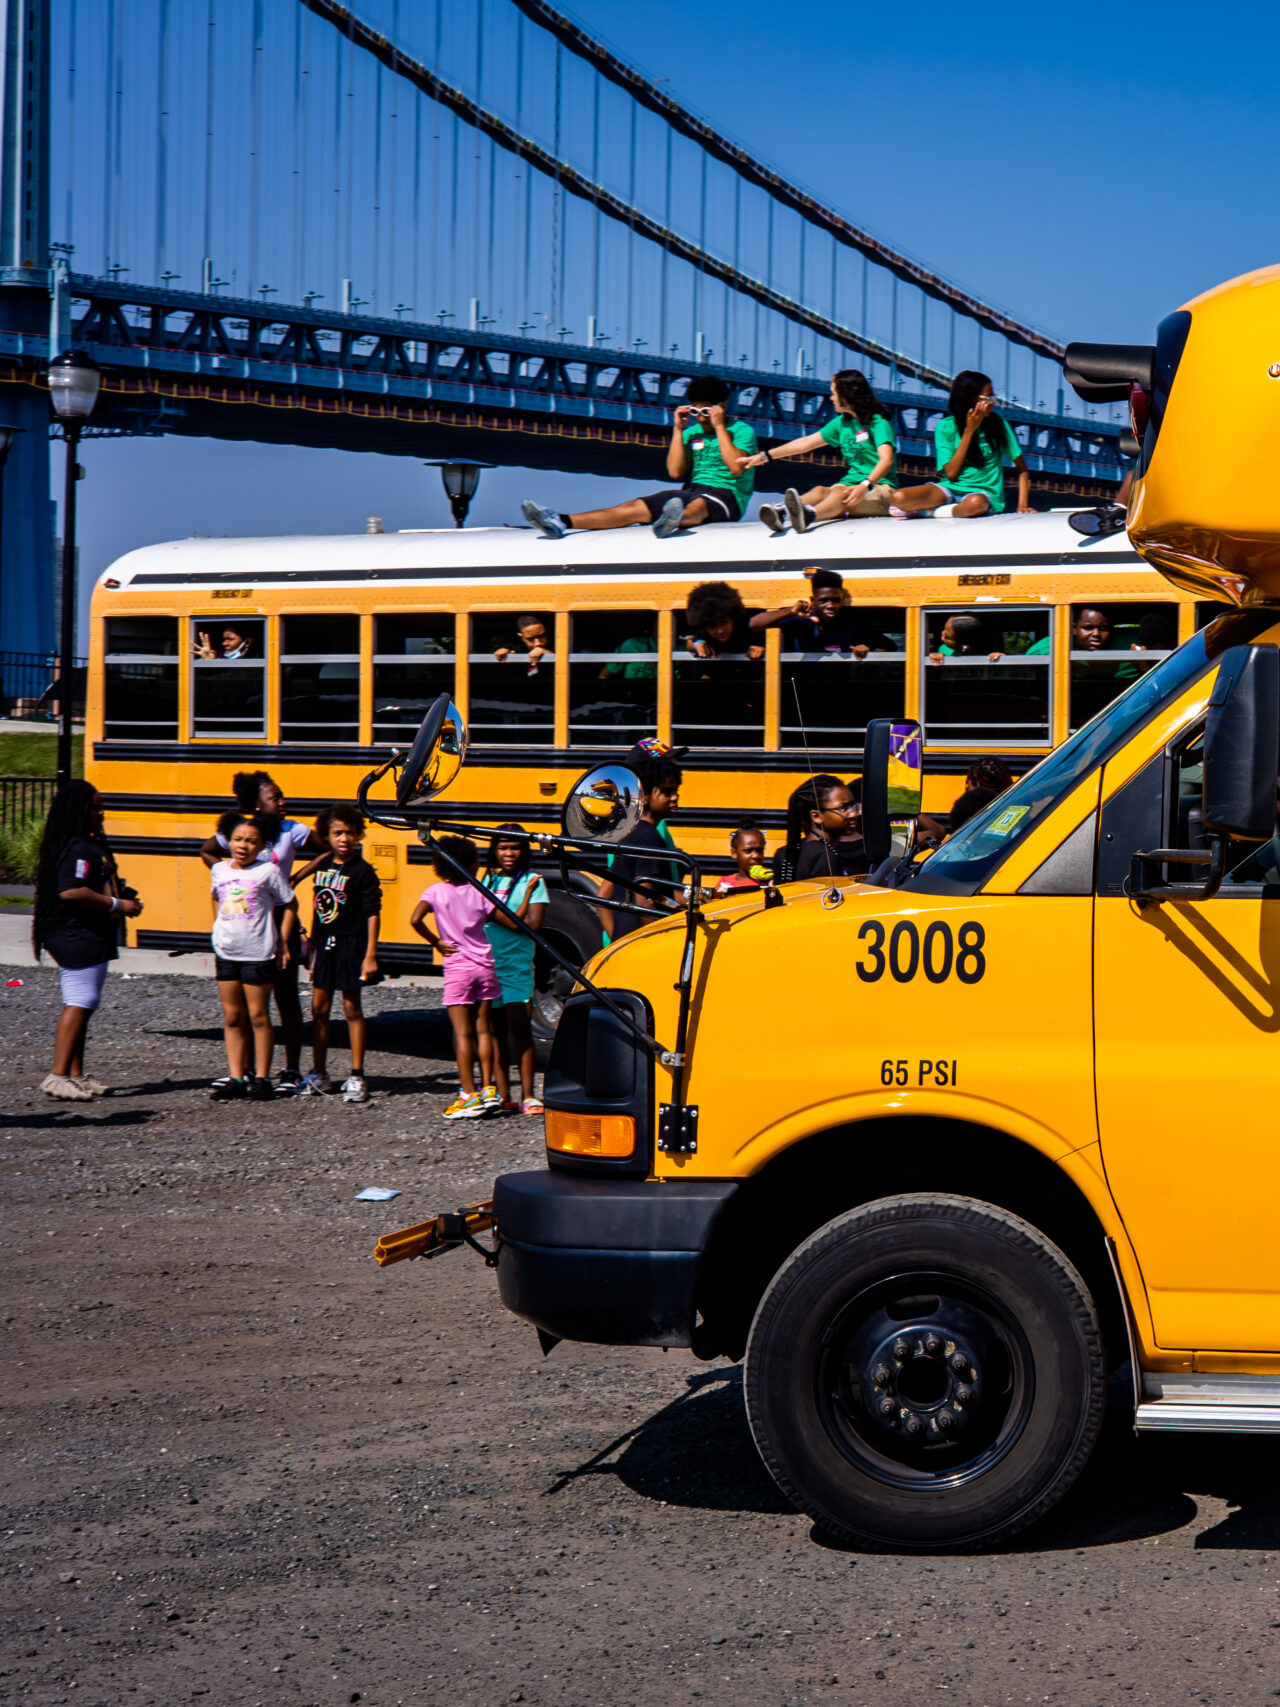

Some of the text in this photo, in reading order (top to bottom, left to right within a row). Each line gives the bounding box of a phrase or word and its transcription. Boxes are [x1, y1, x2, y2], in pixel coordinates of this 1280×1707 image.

[855, 919, 986, 985] 3008
[881, 1059, 957, 1086] 65 PSI
